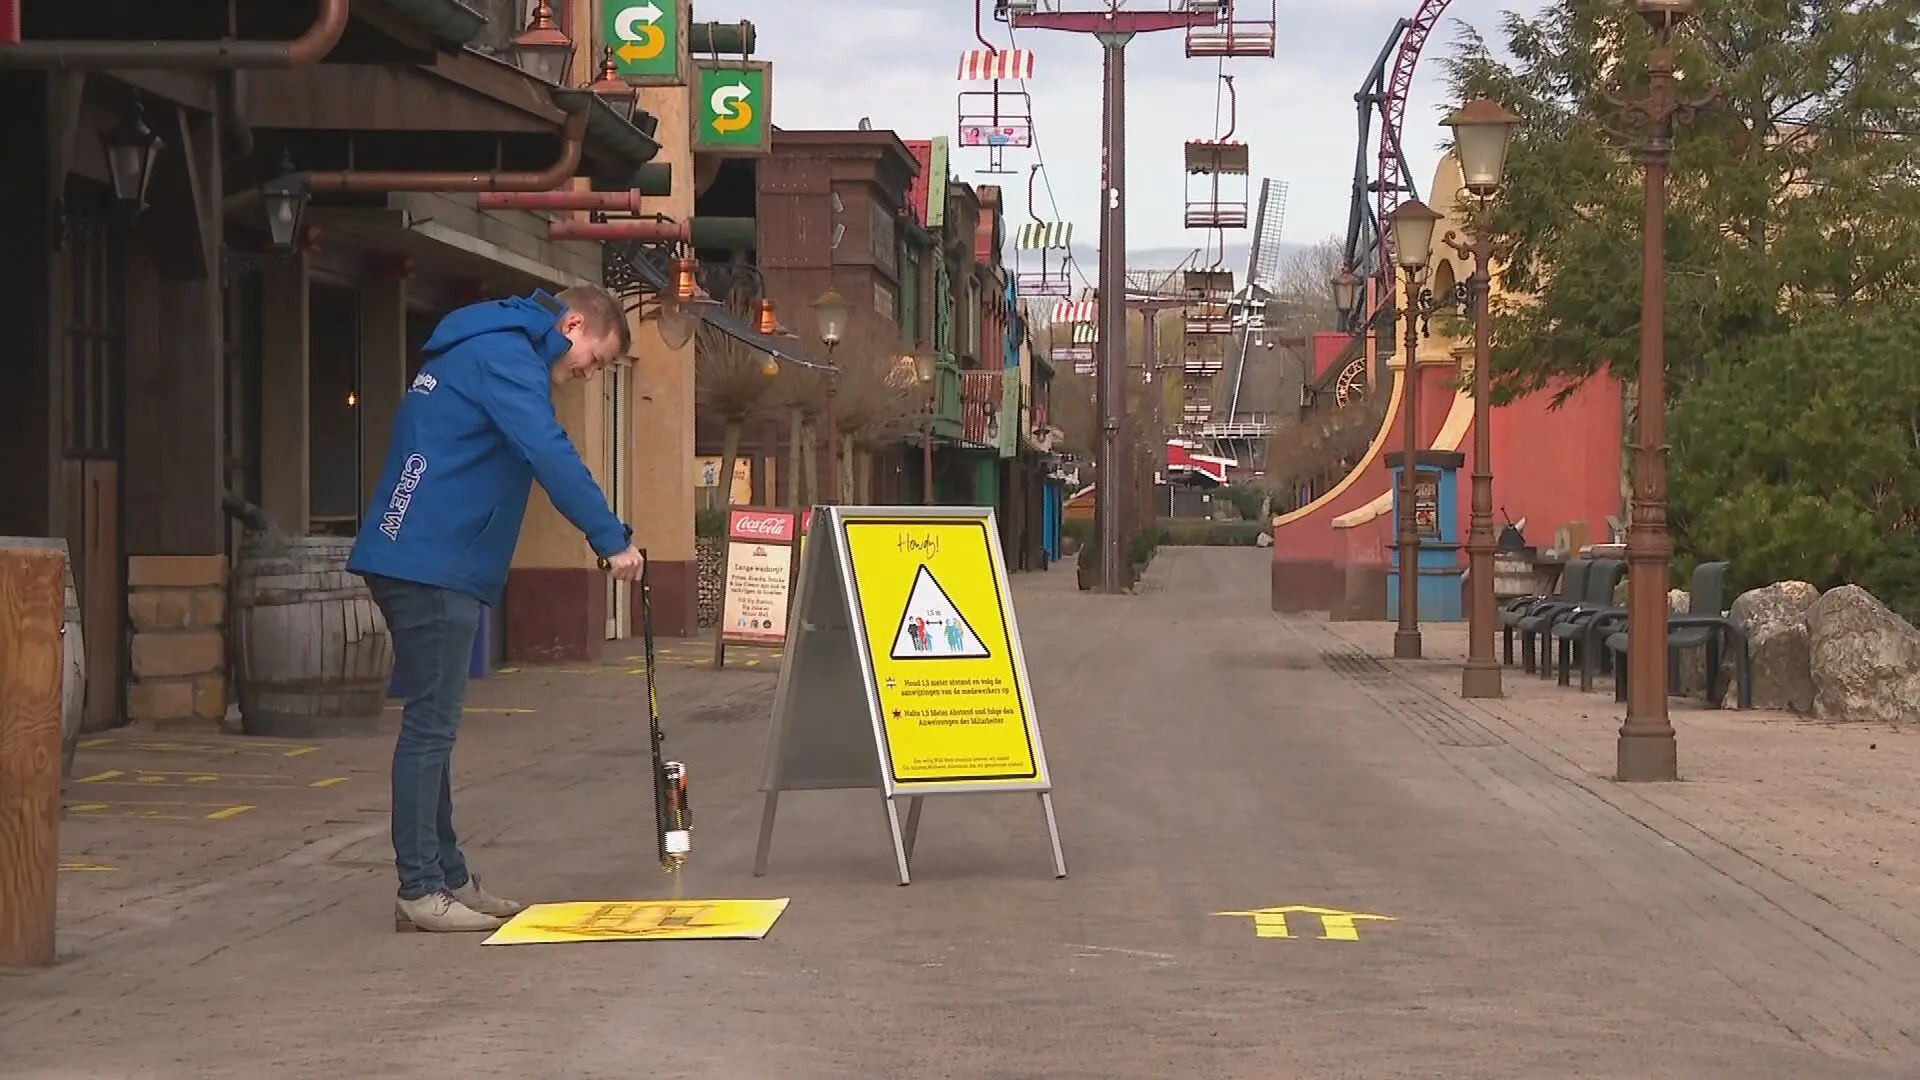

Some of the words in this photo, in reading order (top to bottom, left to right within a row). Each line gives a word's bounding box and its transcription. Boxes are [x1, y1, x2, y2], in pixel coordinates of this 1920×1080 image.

[379, 453, 428, 541] CREW
[736, 515, 786, 535] Coca-Cola
[897, 533, 940, 560] Howdy!
[904, 679, 920, 687] Houd
[949, 677, 971, 686] afstand
[980, 678, 993, 686] volg
[994, 677, 1002, 685] de
[901, 689, 940, 697] aanwijzingen
[953, 687, 961, 695] de
[961, 687, 1001, 695] medewerkers
[1001, 687, 1009, 695] op
[930, 709, 948, 717] Meter
[949, 708, 974, 716] Abstand
